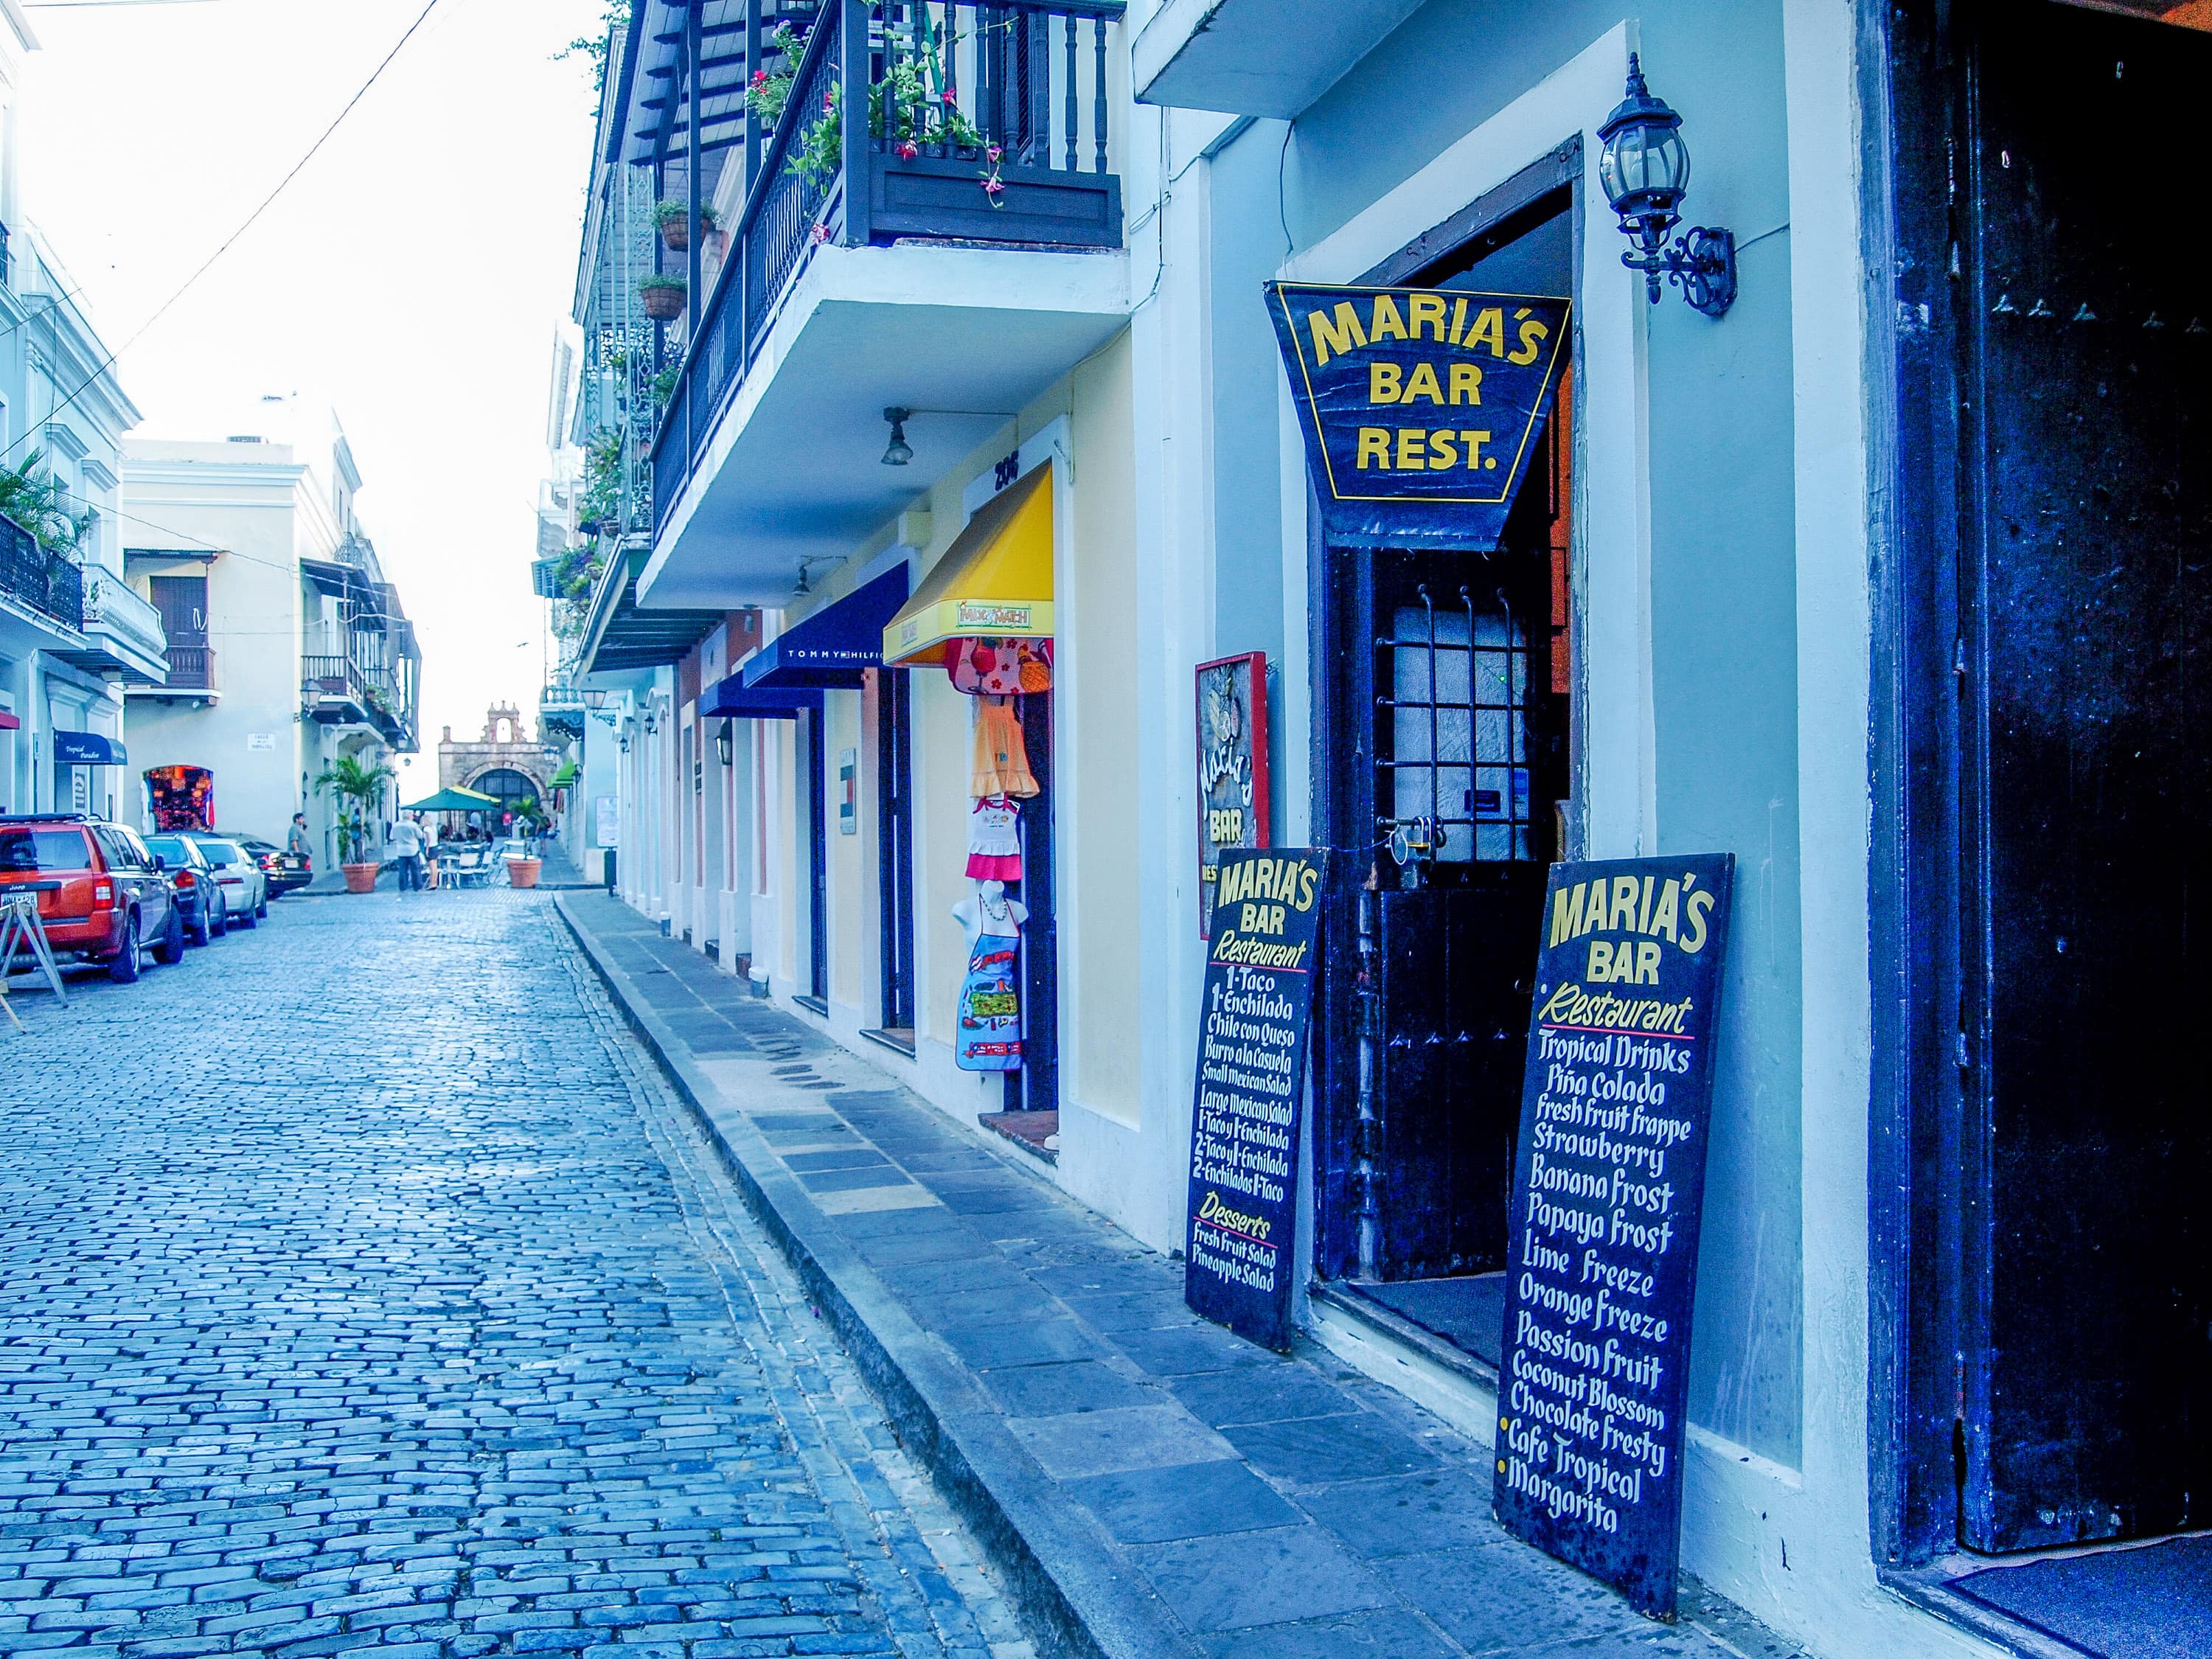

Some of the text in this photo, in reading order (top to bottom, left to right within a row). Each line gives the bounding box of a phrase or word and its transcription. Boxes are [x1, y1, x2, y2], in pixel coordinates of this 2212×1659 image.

[1308, 293, 1548, 366] MARIA'S
[1370, 362, 1483, 405] BAR
[1356, 427, 1497, 470] REST.
[960, 608, 987, 622] MIX
[993, 609, 1027, 624] MATCH
[788, 650, 839, 658] TOMMY
[1209, 809, 1242, 841] BAR
[1218, 858, 1318, 912] MARIA'S
[1240, 903, 1285, 935] BAR
[1550, 872, 1715, 953] MARIA'S
[1213, 929, 1307, 968] Restaurant
[1587, 940, 1661, 985] BAR
[1208, 1012, 1295, 1047] Chile con Queso
[1538, 981, 1693, 1034] Restaurant
[1205, 1034, 1234, 1062] Burro
[1253, 1047, 1292, 1074] Casuela
[1538, 1029, 1691, 1074] Tropical Drinks
[1202, 1060, 1228, 1082] Small
[1266, 1074, 1292, 1096] Salad
[1545, 1062, 1665, 1105] Piña Colada
[1200, 1084, 1228, 1116] Large
[1267, 1100, 1293, 1127] Salad
[1225, 1122, 1233, 1140] y
[1533, 1121, 1664, 1178] Strawberry
[1226, 1149, 1233, 1167] y
[1528, 1152, 1607, 1200] Banana
[1199, 1191, 1271, 1239] Desserts
[1526, 1192, 1604, 1244] Papaya
[1192, 1243, 1274, 1292] Pineapple Salad
[1248, 1244, 1276, 1269] Salad
[1521, 1228, 1570, 1273] Lime
[1520, 1272, 1593, 1325] Orange
[1515, 1310, 1599, 1368] Passion
[1512, 1349, 1665, 1431] Coconut Blossom
[1512, 1380, 1599, 1440] Chocolate
[1509, 1418, 1641, 1504] Cafe Tropical
[1506, 1456, 1617, 1534] Margarita
